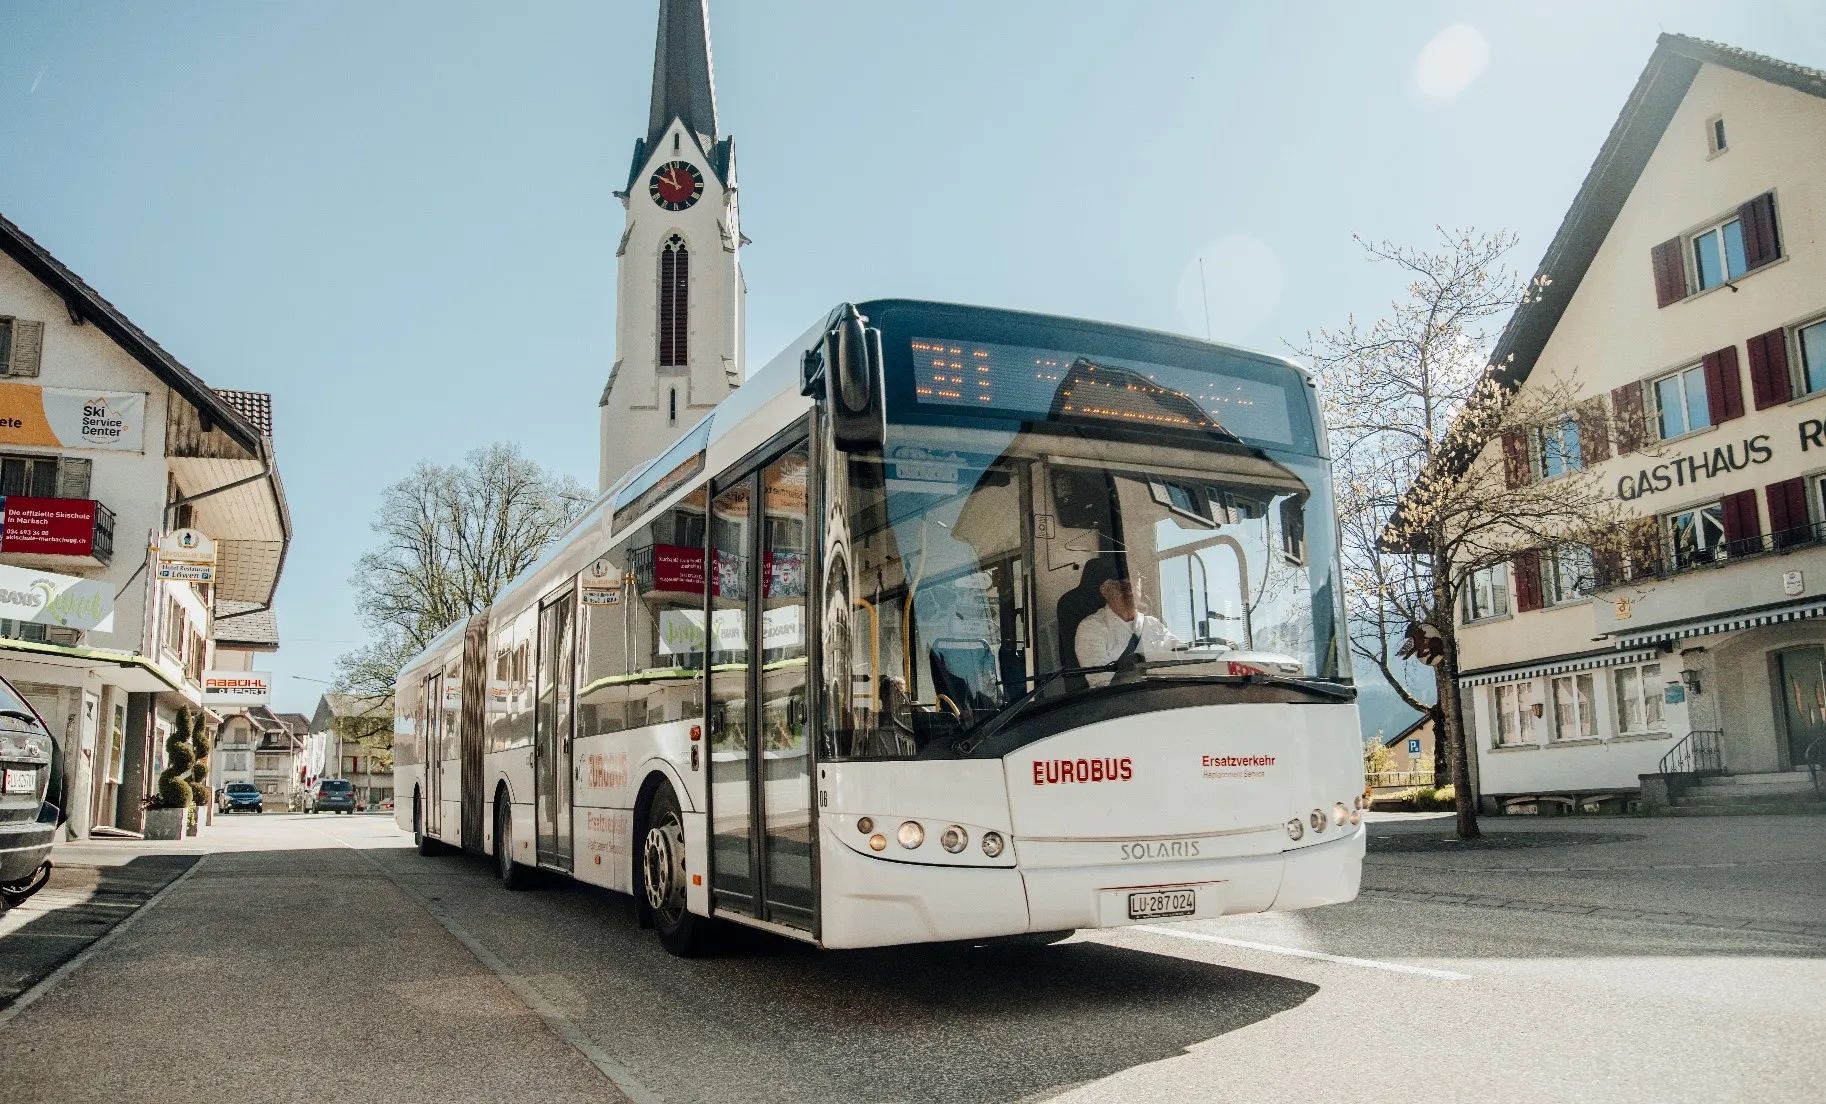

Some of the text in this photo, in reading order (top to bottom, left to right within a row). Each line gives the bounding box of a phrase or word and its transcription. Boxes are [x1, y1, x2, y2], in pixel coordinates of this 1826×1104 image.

[83, 405, 105, 418] Ski
[82, 417, 122, 427] Service
[82, 426, 121, 437] Center
[1617, 419, 1826, 501] GASTHAUS R
[22, 510, 54, 518] offizielle
[55, 511, 90, 520] Skischule
[16, 517, 48, 525] Marbach
[180, 565, 210, 573] Restaurant
[172, 571, 199, 579] Löwen
[206, 679, 267, 688] ABBÜHL
[1202, 755, 1276, 767] Ersatzverkehr
[1033, 757, 1132, 785] EUROBUS
[819, 790, 828, 807] 06
[1121, 841, 1200, 861] SOLARIS
